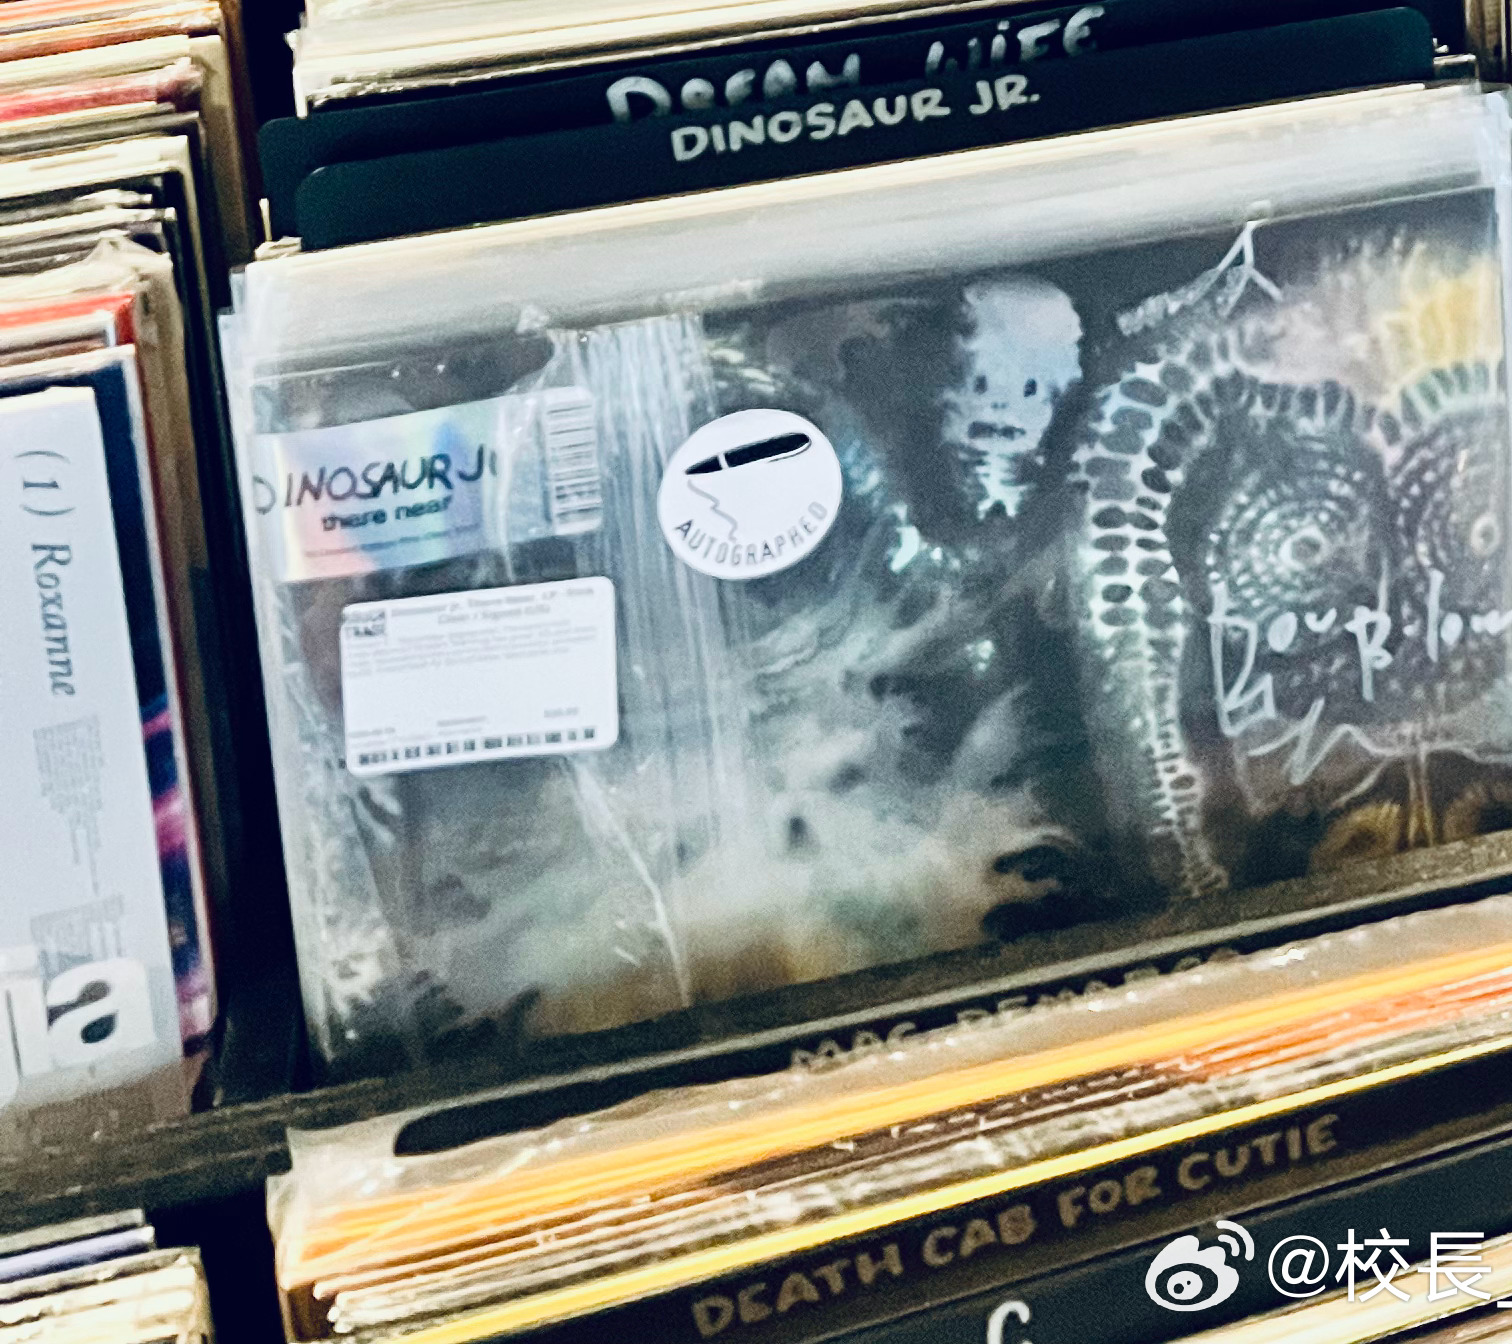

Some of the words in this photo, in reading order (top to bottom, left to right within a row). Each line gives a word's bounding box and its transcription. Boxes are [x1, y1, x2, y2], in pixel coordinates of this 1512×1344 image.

[670, 87, 951, 163] DINOSAUR
[968, 74, 1041, 117] JR.
[13, 449, 77, 517] (1)
[251, 453, 457, 515] DINOSAUR
[321, 508, 388, 532] there
[674, 499, 830, 568] AUTOGRAPHED
[31, 542, 77, 698] Roxanne
[690, 1240, 904, 1342] DEATH
[921, 1208, 1032, 1272] CAB
[1056, 1165, 1165, 1231] FOR
[1173, 1113, 1342, 1194] CUTIE
[985, 1301, 1030, 1344] C
